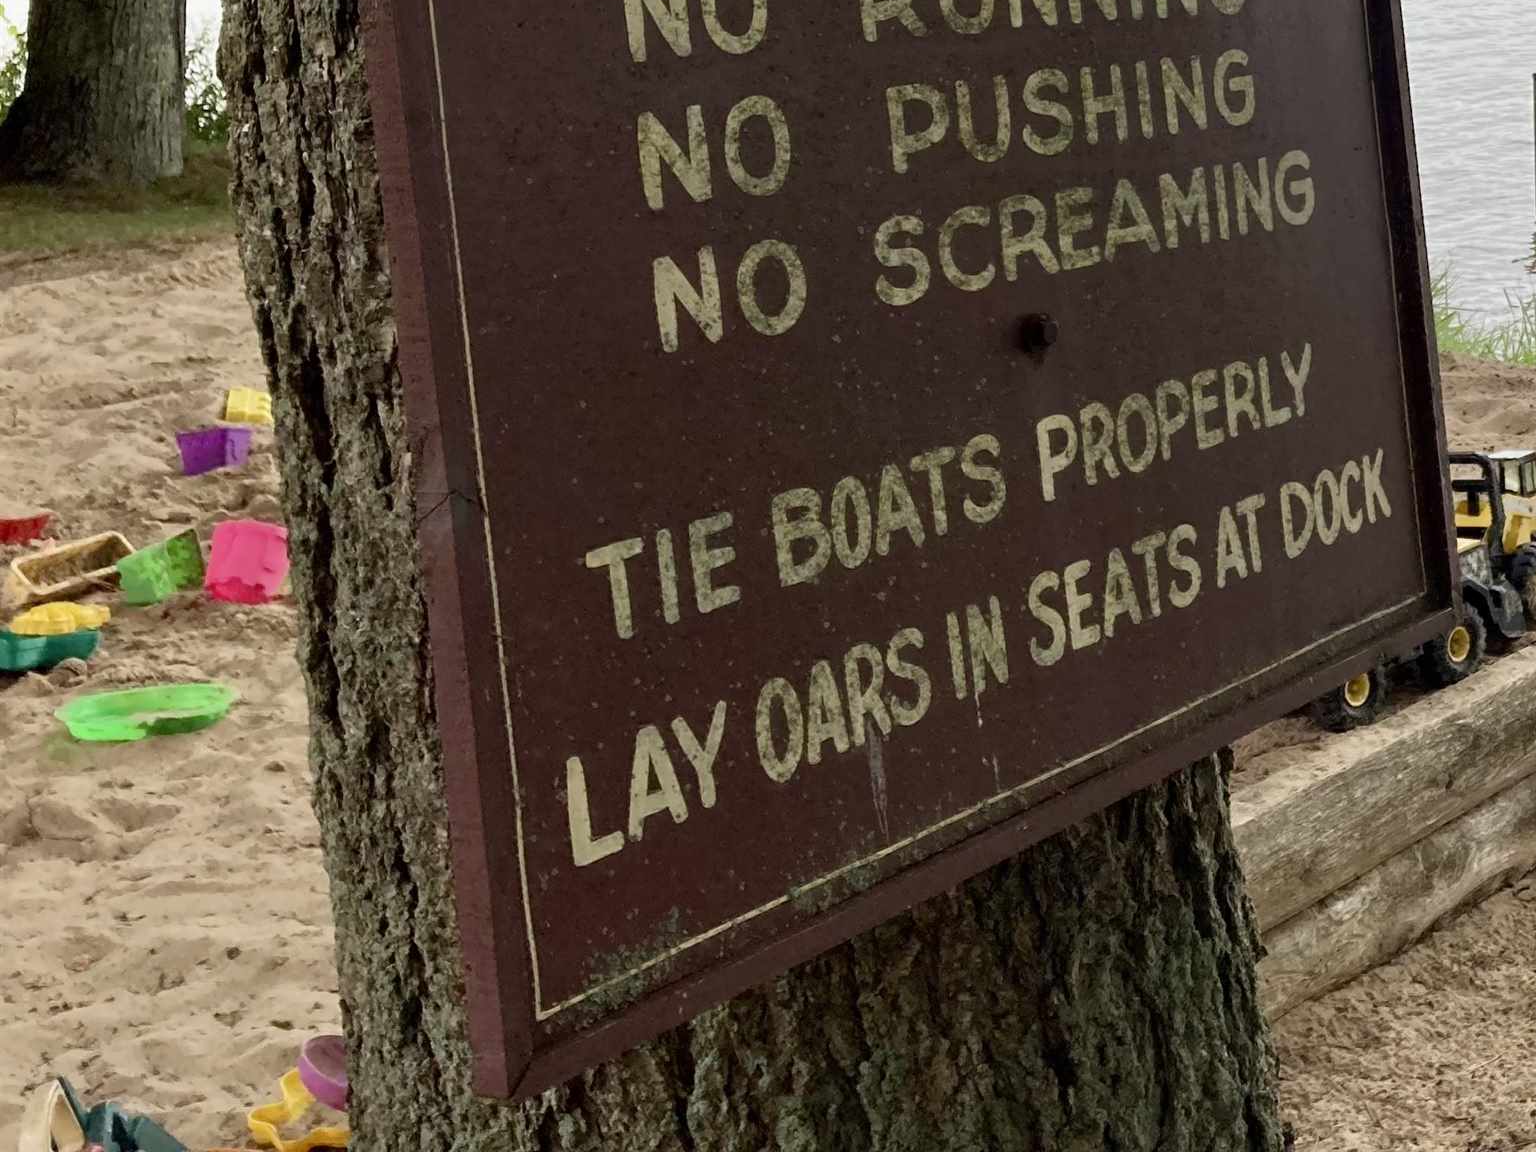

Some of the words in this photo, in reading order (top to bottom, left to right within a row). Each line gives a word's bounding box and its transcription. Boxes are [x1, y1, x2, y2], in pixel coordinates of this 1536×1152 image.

[635, 93, 792, 211] NO
[885, 47, 1257, 174] PUSHING
[651, 238, 808, 354] NO
[873, 148, 1318, 307] SCREAMING
[584, 510, 742, 641] TIE
[770, 433, 1008, 589] BOATS
[1035, 341, 1314, 503] PROPERLY
[564, 699, 728, 868] LAY
[755, 626, 933, 784] OARS
[945, 595, 1010, 701] IN
[1027, 522, 1203, 668] SEATS
[1215, 492, 1266, 589] AT
[1278, 448, 1394, 560] DOCK
